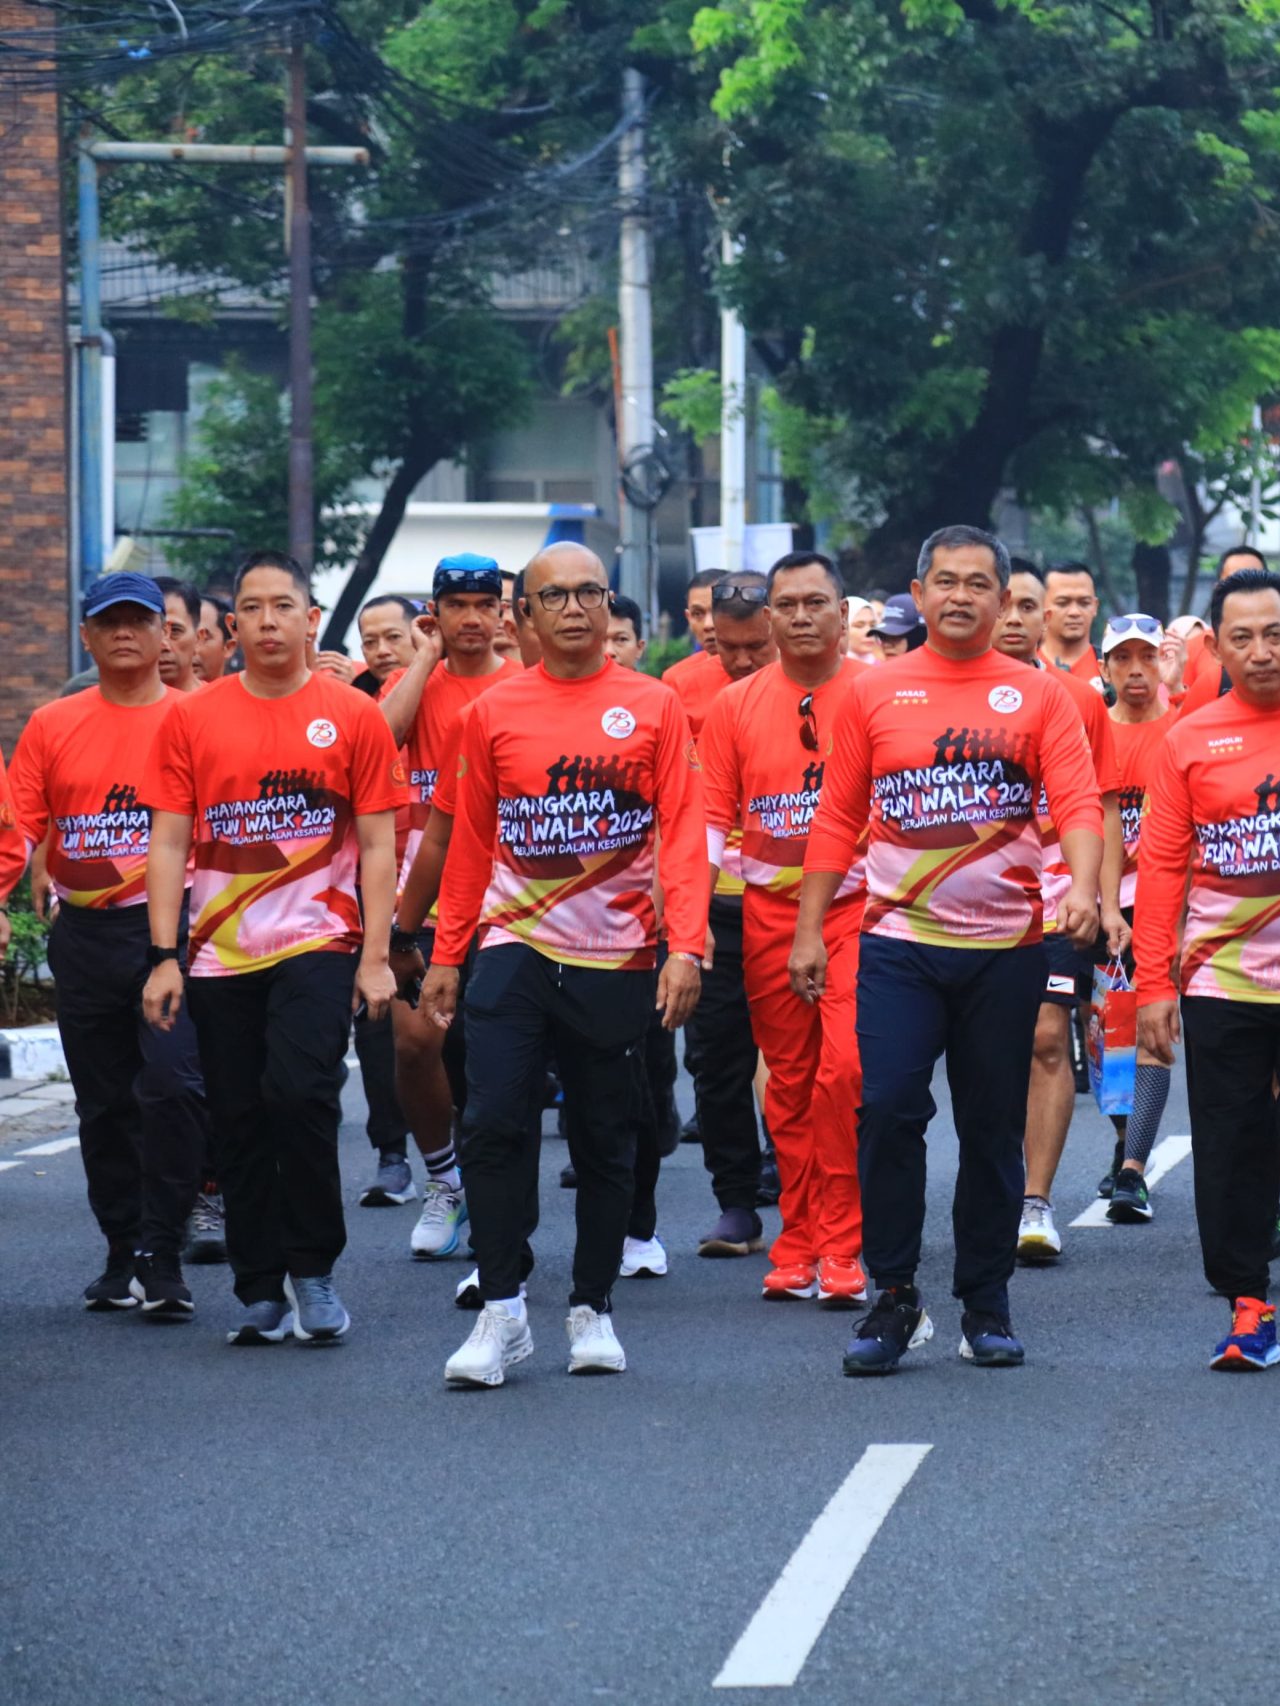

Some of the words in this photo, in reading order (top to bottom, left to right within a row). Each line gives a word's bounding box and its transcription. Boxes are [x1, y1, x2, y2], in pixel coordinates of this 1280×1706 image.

[882, 793, 913, 821] FUN
[921, 784, 990, 812] WALK
[212, 819, 240, 838] FUN
[245, 812, 296, 833] WALK
[500, 820, 526, 843] FUN
[532, 814, 600, 842] WALK
[607, 804, 654, 836] 2024
[761, 811, 785, 830] FUN
[901, 814, 948, 830] BERJALAN
[951, 811, 987, 823] DALAM
[85, 828, 135, 848] WALK
[265, 832, 292, 841] DALAM
[513, 845, 556, 858] BERJALAN
[558, 842, 595, 854] DALAM
[598, 833, 642, 850] KESATUAN
[1202, 842, 1236, 868] FUN
[1220, 861, 1268, 876] BERJALAN
